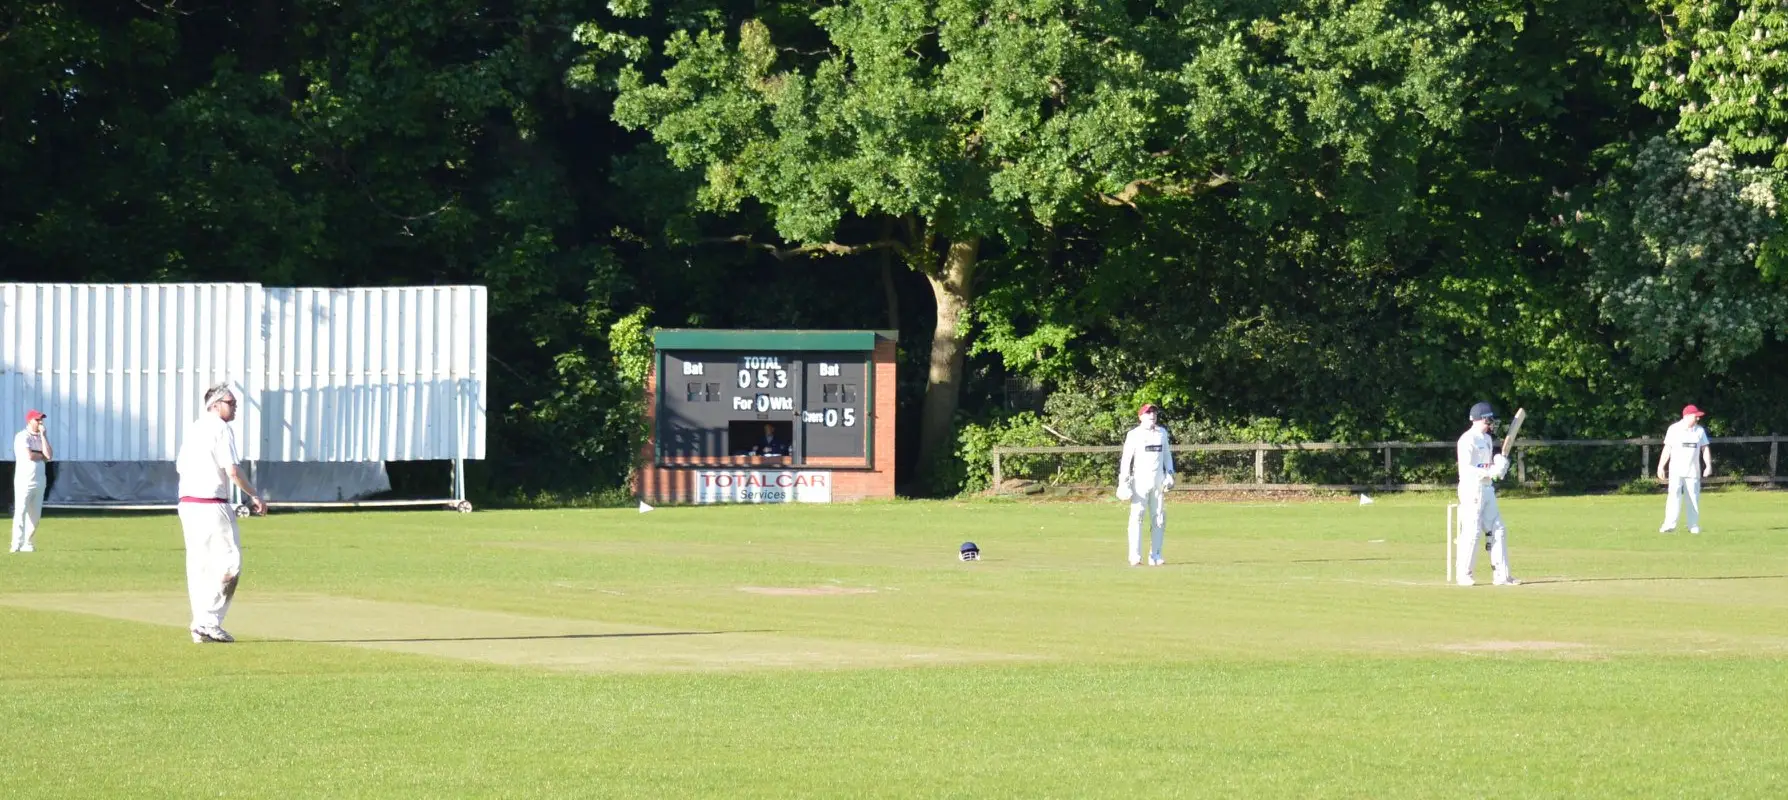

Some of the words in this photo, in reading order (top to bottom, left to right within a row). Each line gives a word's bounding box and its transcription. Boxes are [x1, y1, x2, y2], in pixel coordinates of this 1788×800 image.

[683, 361, 703, 375] Bat
[744, 357, 782, 370] TOTAL
[819, 363, 839, 376] Bat
[733, 396, 753, 410] For
[757, 394, 769, 412] 0
[770, 396, 793, 410] Wkt
[740, 489, 786, 500] Services
